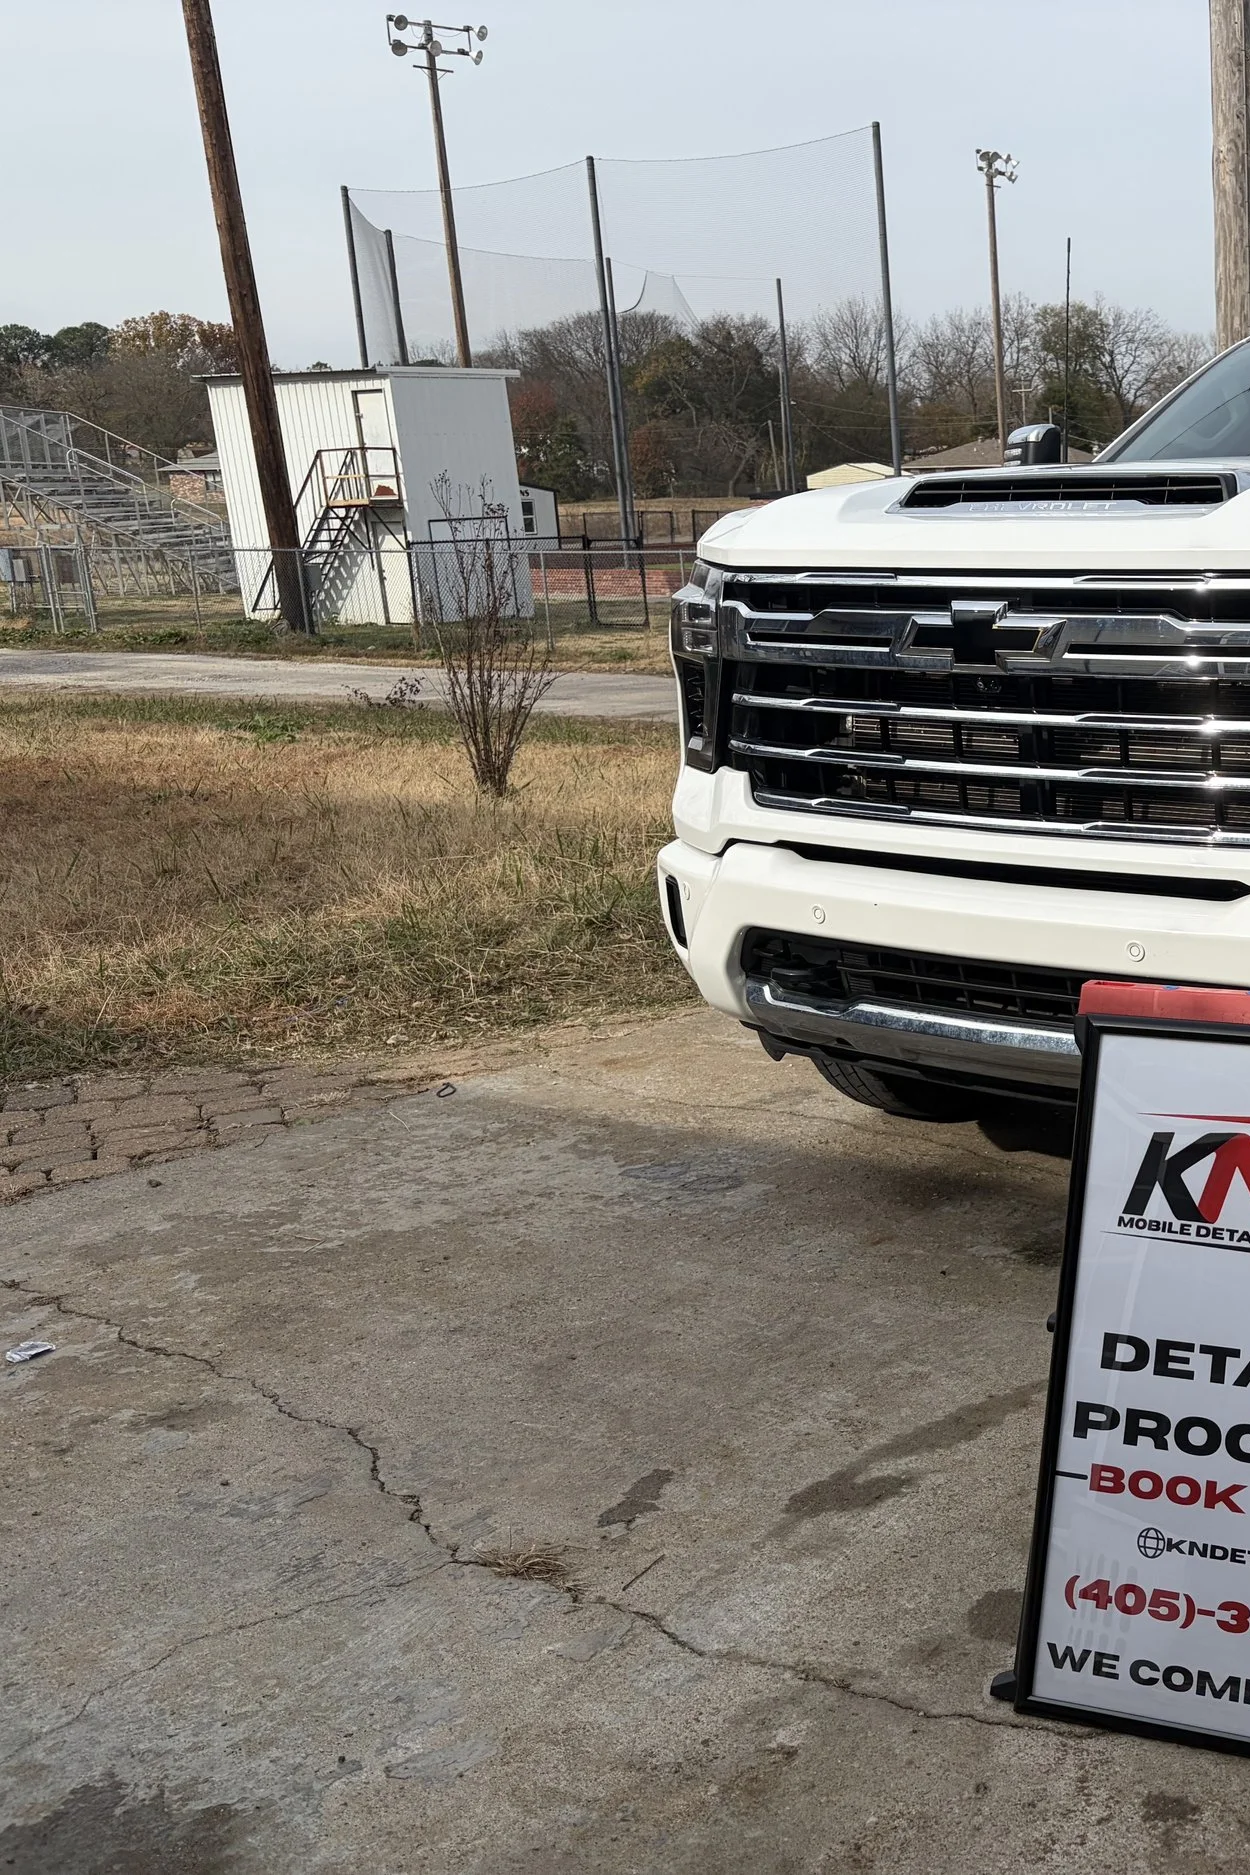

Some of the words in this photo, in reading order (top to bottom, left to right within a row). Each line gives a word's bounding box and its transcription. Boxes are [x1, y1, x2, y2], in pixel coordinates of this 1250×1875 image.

[1117, 1215, 1192, 1237] MOBILE
[1088, 1462, 1249, 1515] BOOK
[1047, 1641, 1121, 1681] WE
